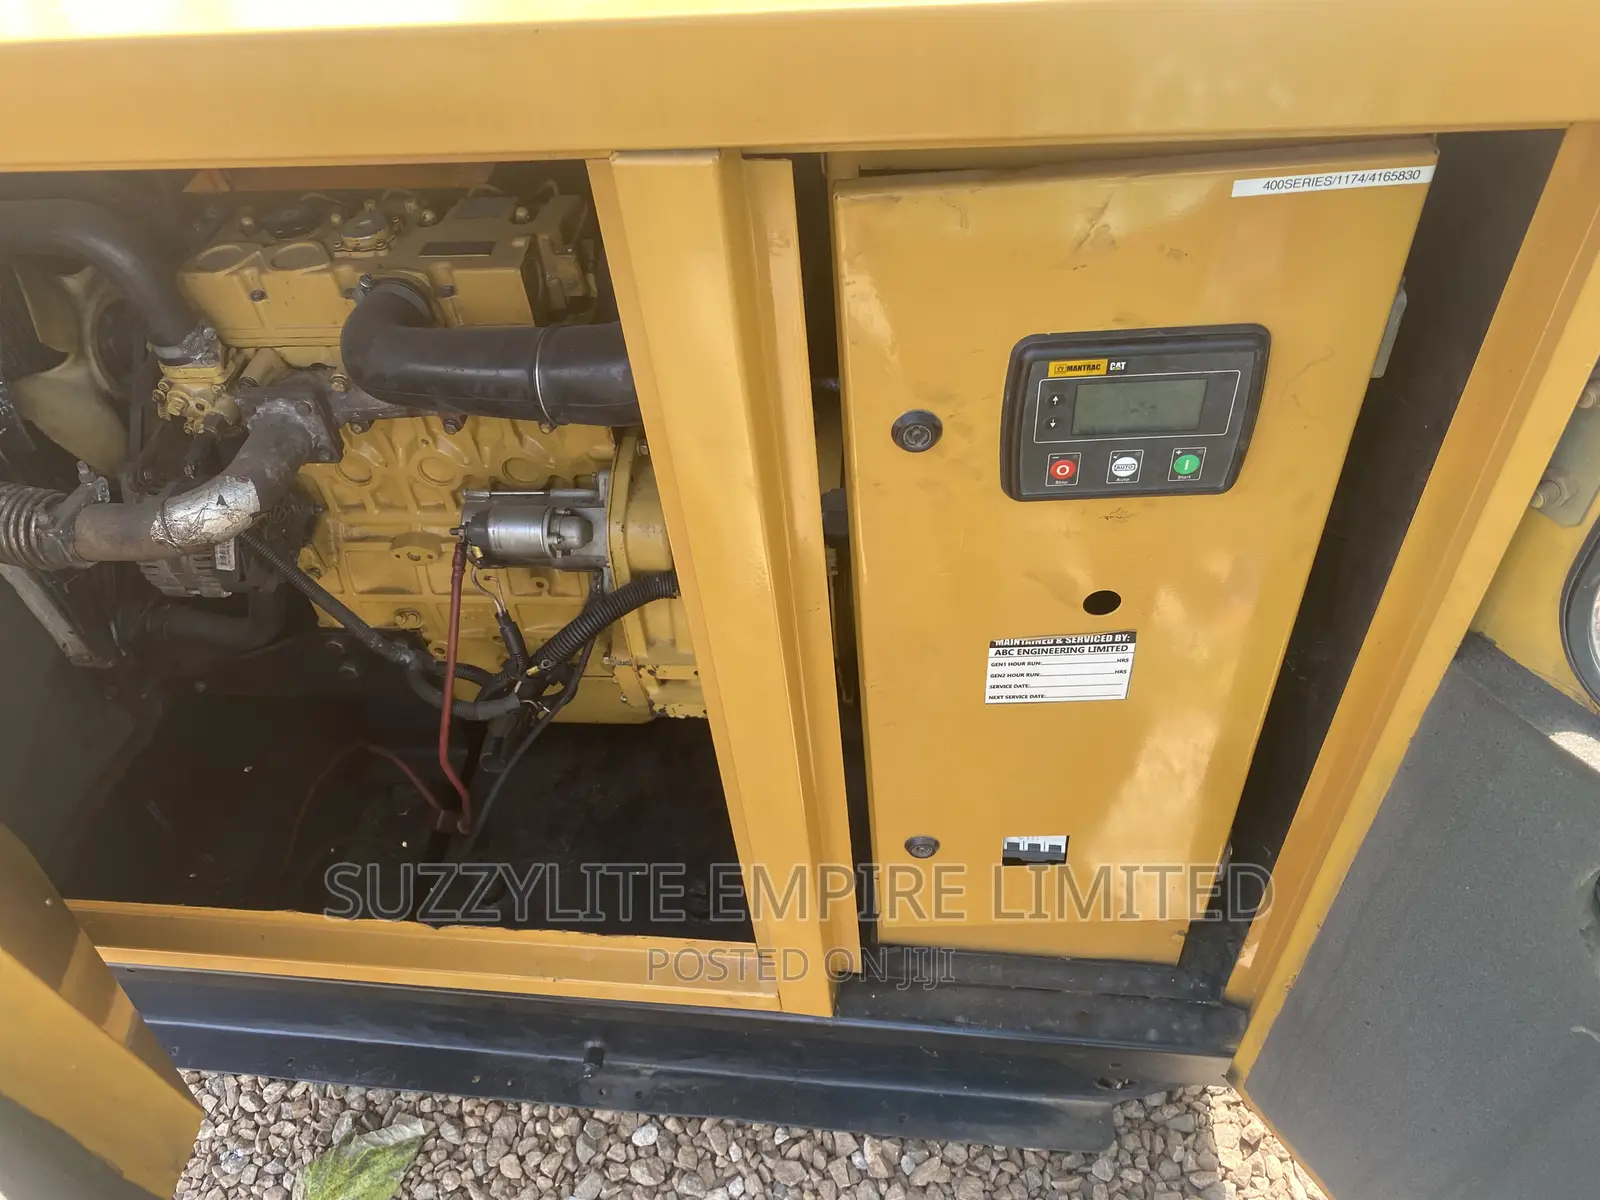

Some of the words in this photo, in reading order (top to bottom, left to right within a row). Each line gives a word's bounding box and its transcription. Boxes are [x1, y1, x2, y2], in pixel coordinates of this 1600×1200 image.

[1262, 169, 1421, 191] 400SERIES/1174/4165830
[1066, 364, 1101, 372] MANTRAC
[1109, 361, 1127, 371] CAT
[1065, 634, 1113, 644] SERVICED
[1114, 633, 1131, 642] BY:
[994, 648, 1015, 656] ABC
[1017, 646, 1086, 656] ENGINEERING
[1087, 644, 1129, 653] LIMITED
